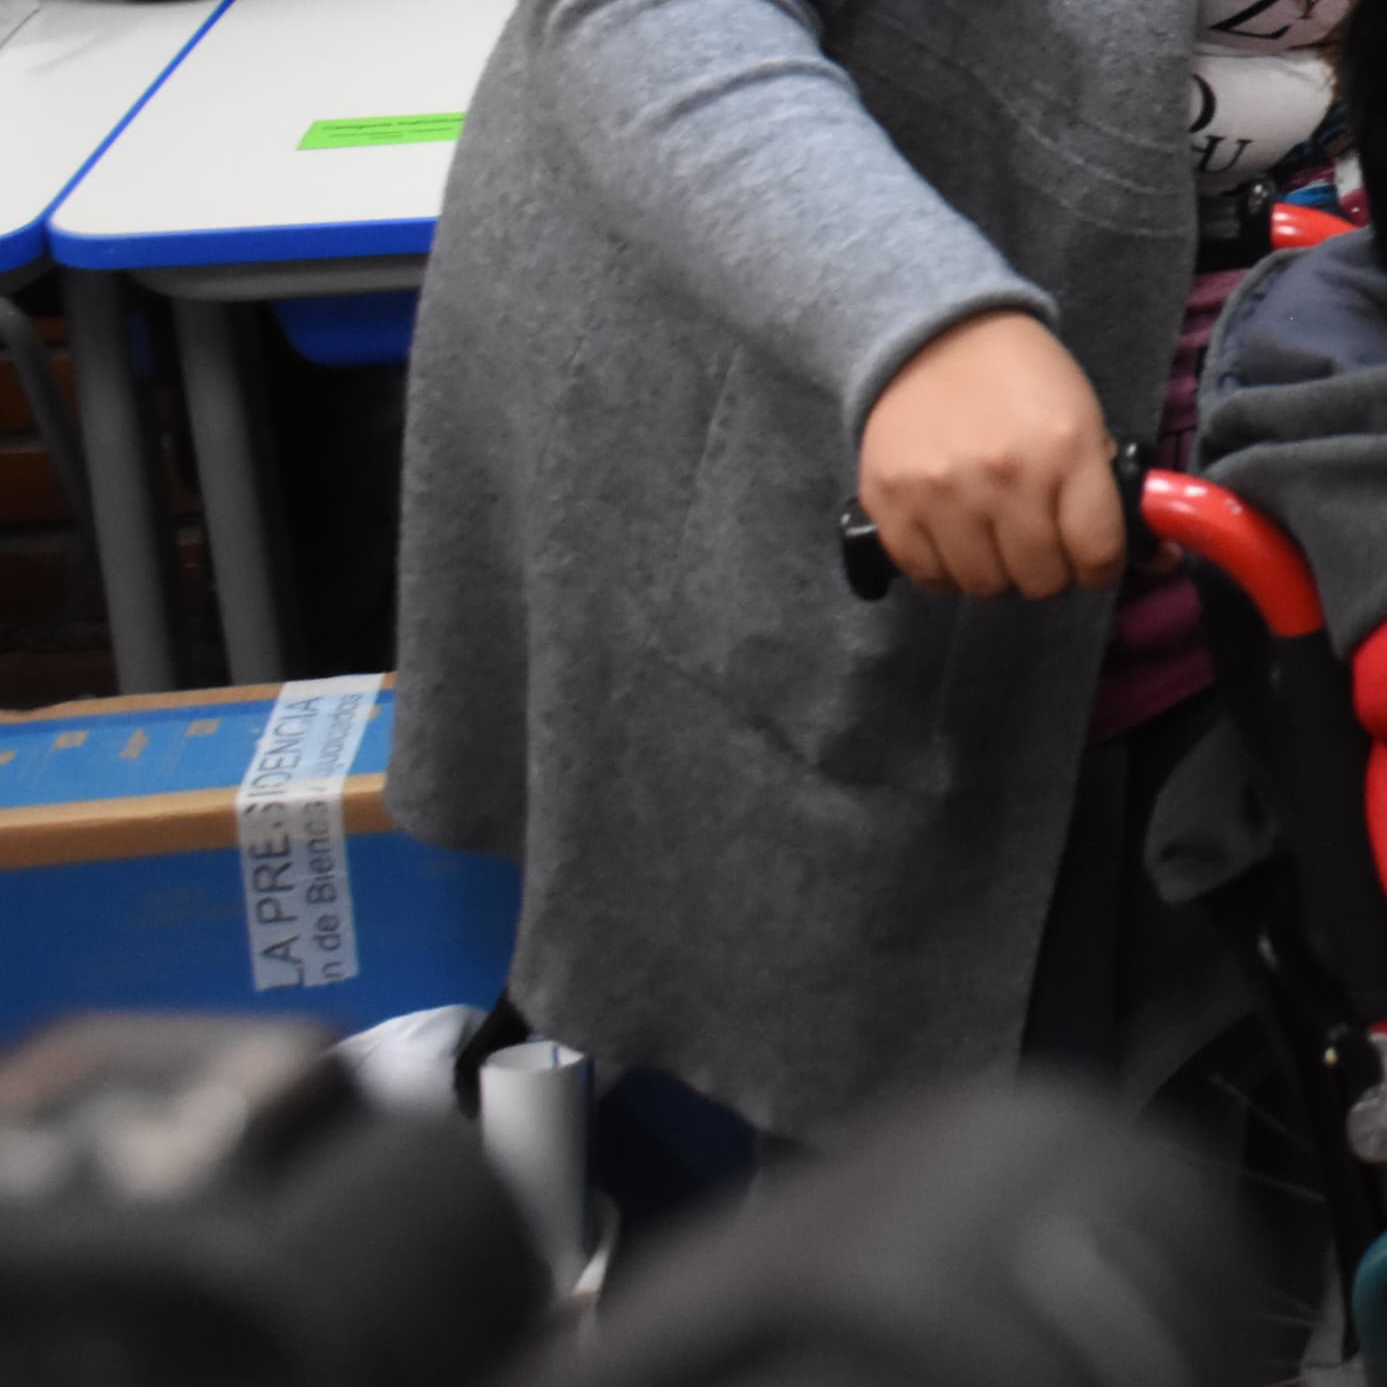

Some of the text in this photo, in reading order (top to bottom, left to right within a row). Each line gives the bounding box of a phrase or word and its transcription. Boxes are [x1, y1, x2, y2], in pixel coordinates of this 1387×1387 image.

[244, 694, 324, 988] LA PRESIDENCIA
[311, 914, 342, 953] de
